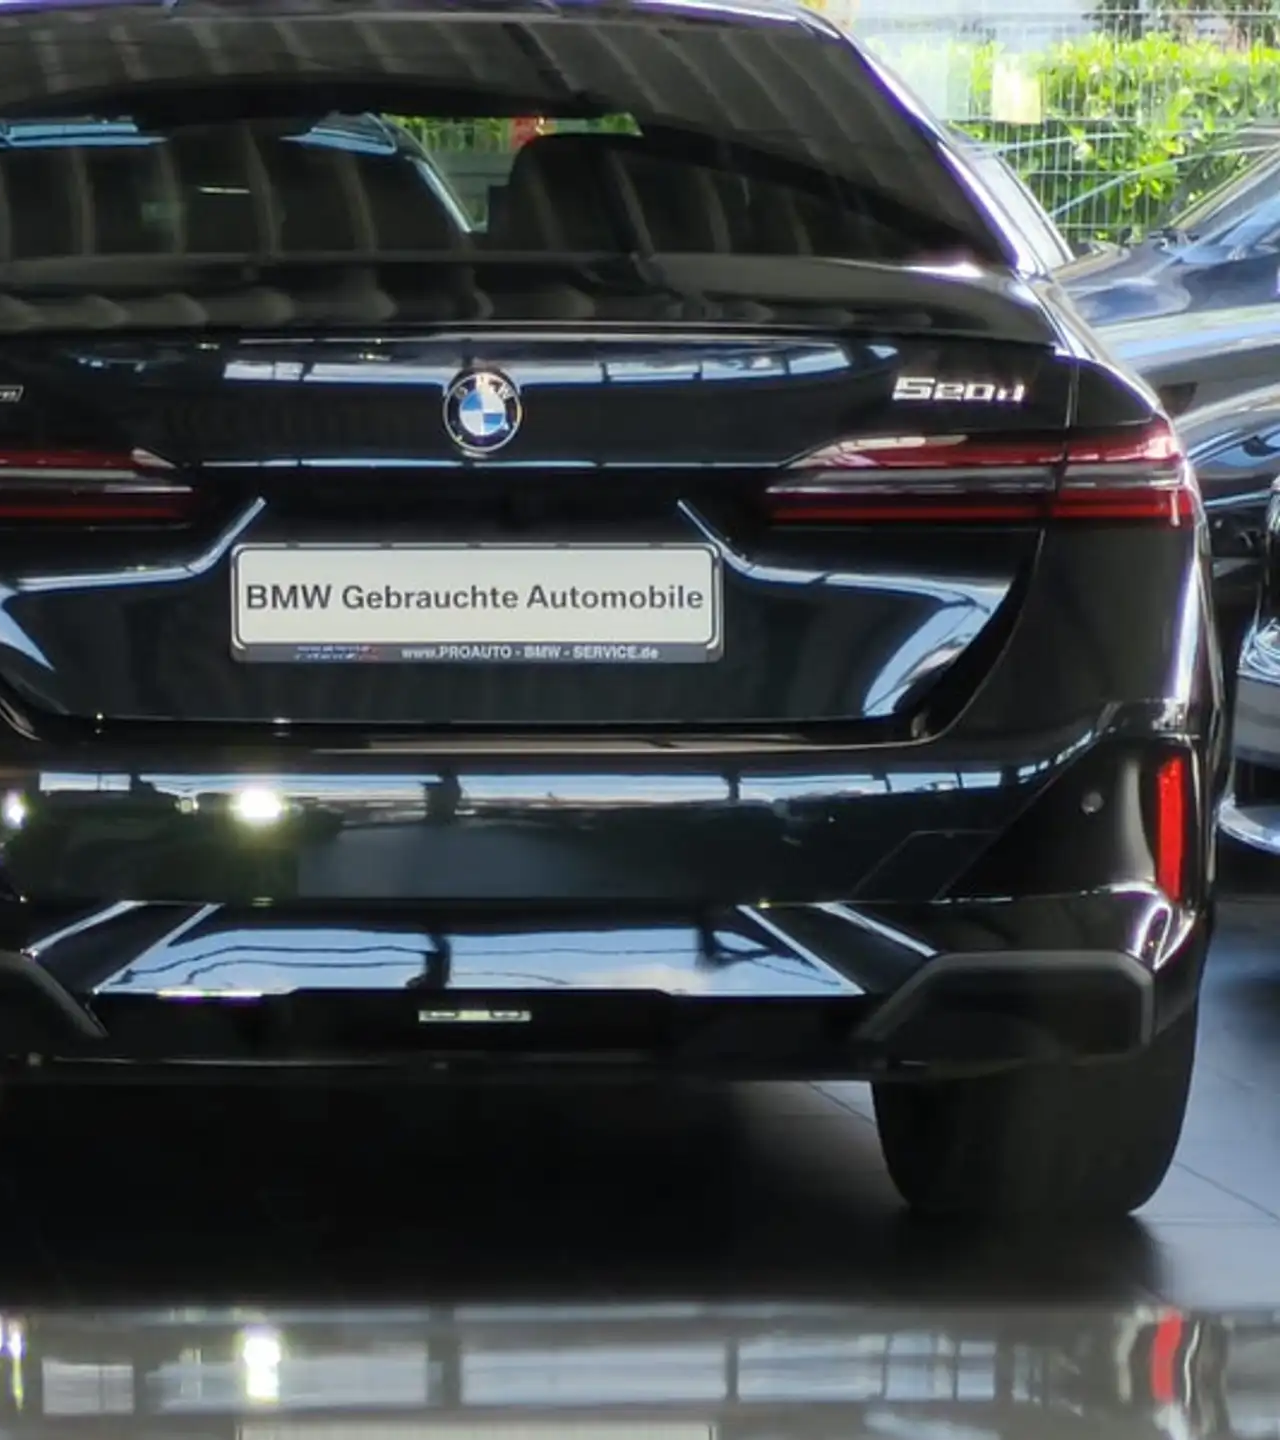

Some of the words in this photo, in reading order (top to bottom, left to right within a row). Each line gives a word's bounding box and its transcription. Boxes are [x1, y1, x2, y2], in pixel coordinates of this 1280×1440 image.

[247, 584, 332, 609] BMW
[342, 584, 519, 610] Gebrauchte
[526, 584, 703, 610] Automobile
[524, 645, 561, 659] BMW
